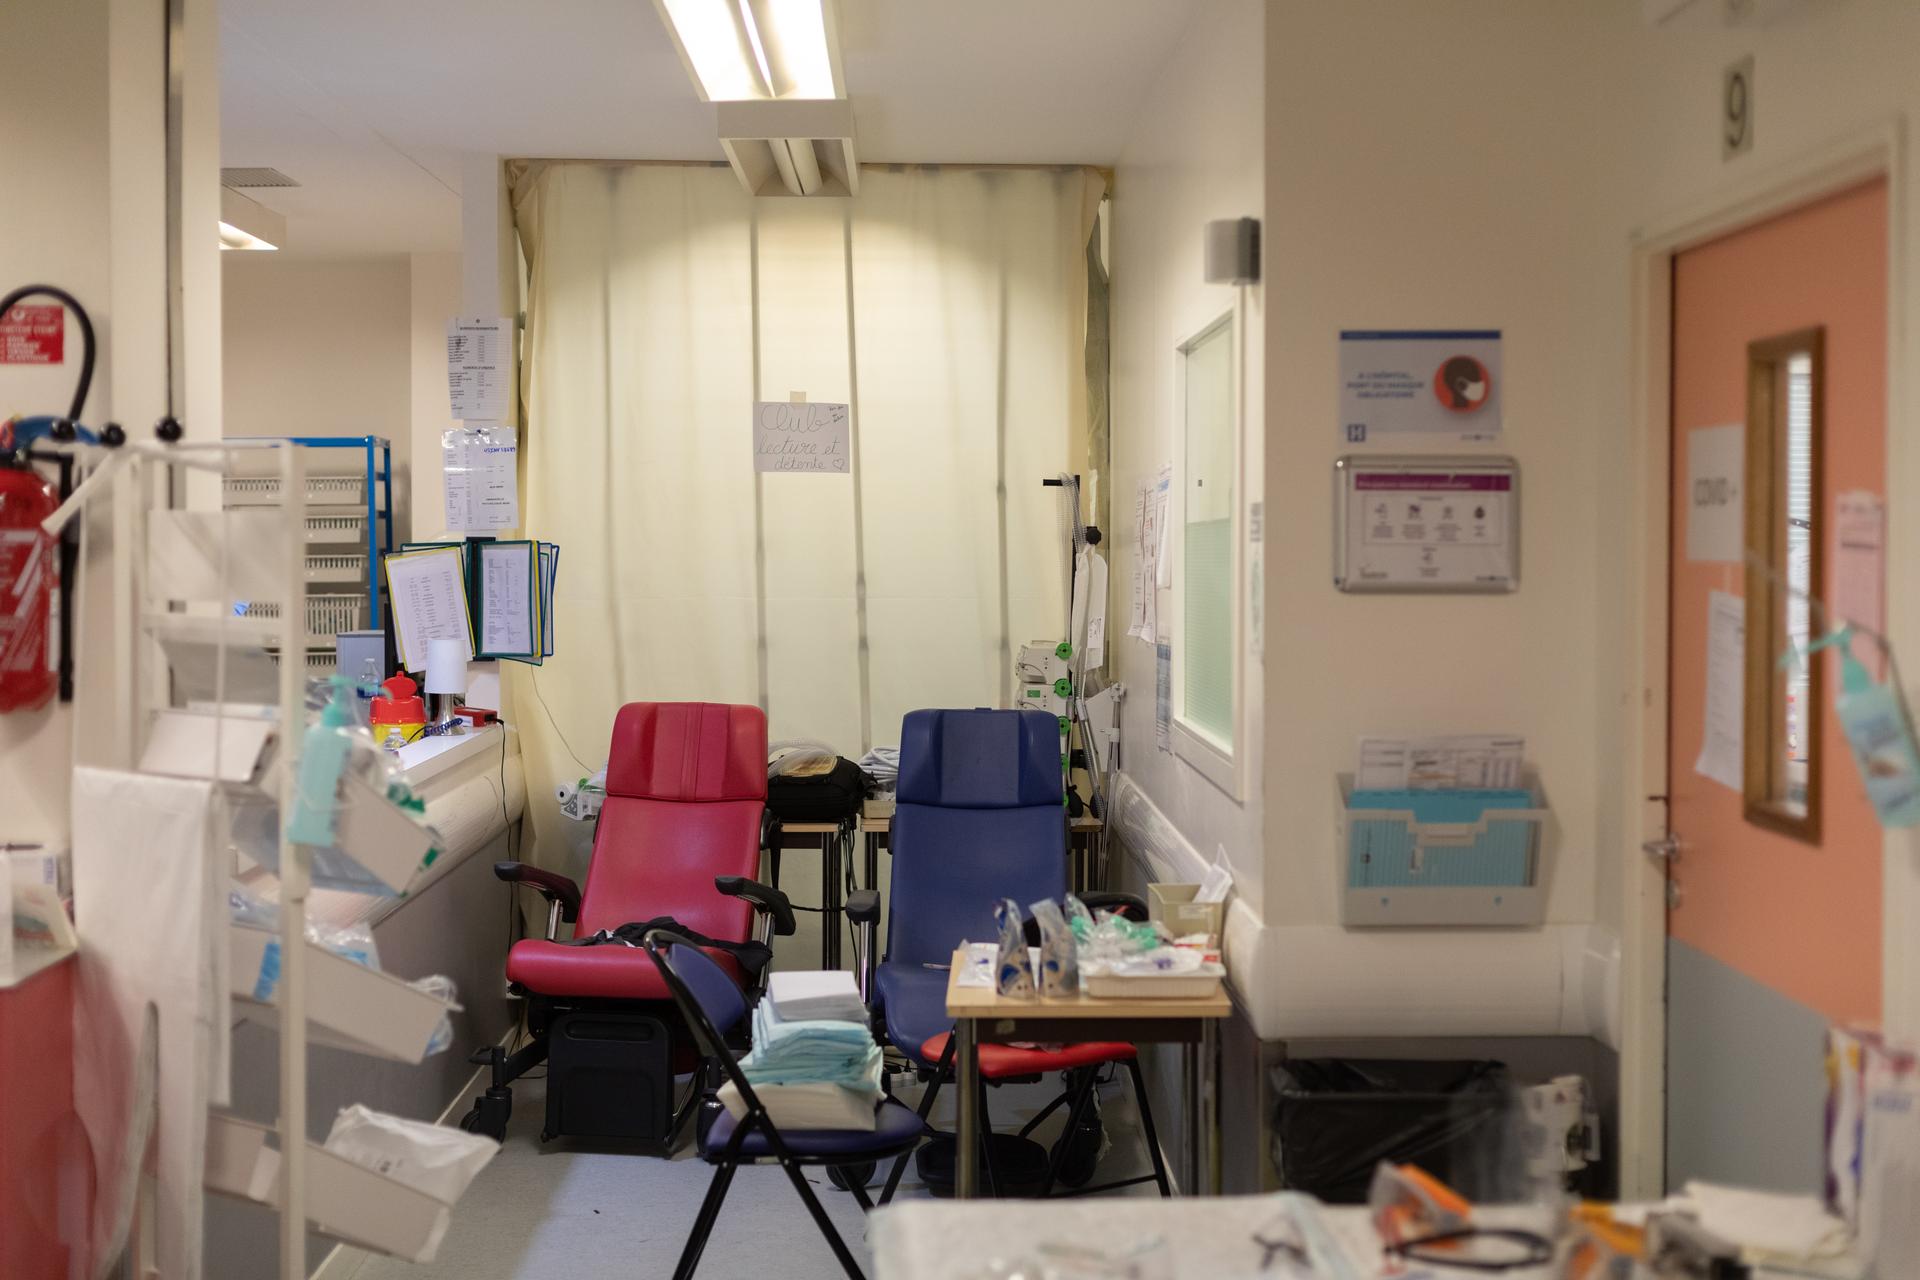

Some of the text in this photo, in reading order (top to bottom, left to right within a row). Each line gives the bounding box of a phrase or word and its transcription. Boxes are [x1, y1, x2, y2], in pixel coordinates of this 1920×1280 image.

[1728, 72, 1746, 148] 9
[761, 403, 829, 433] Club
[822, 435, 840, 456] et
